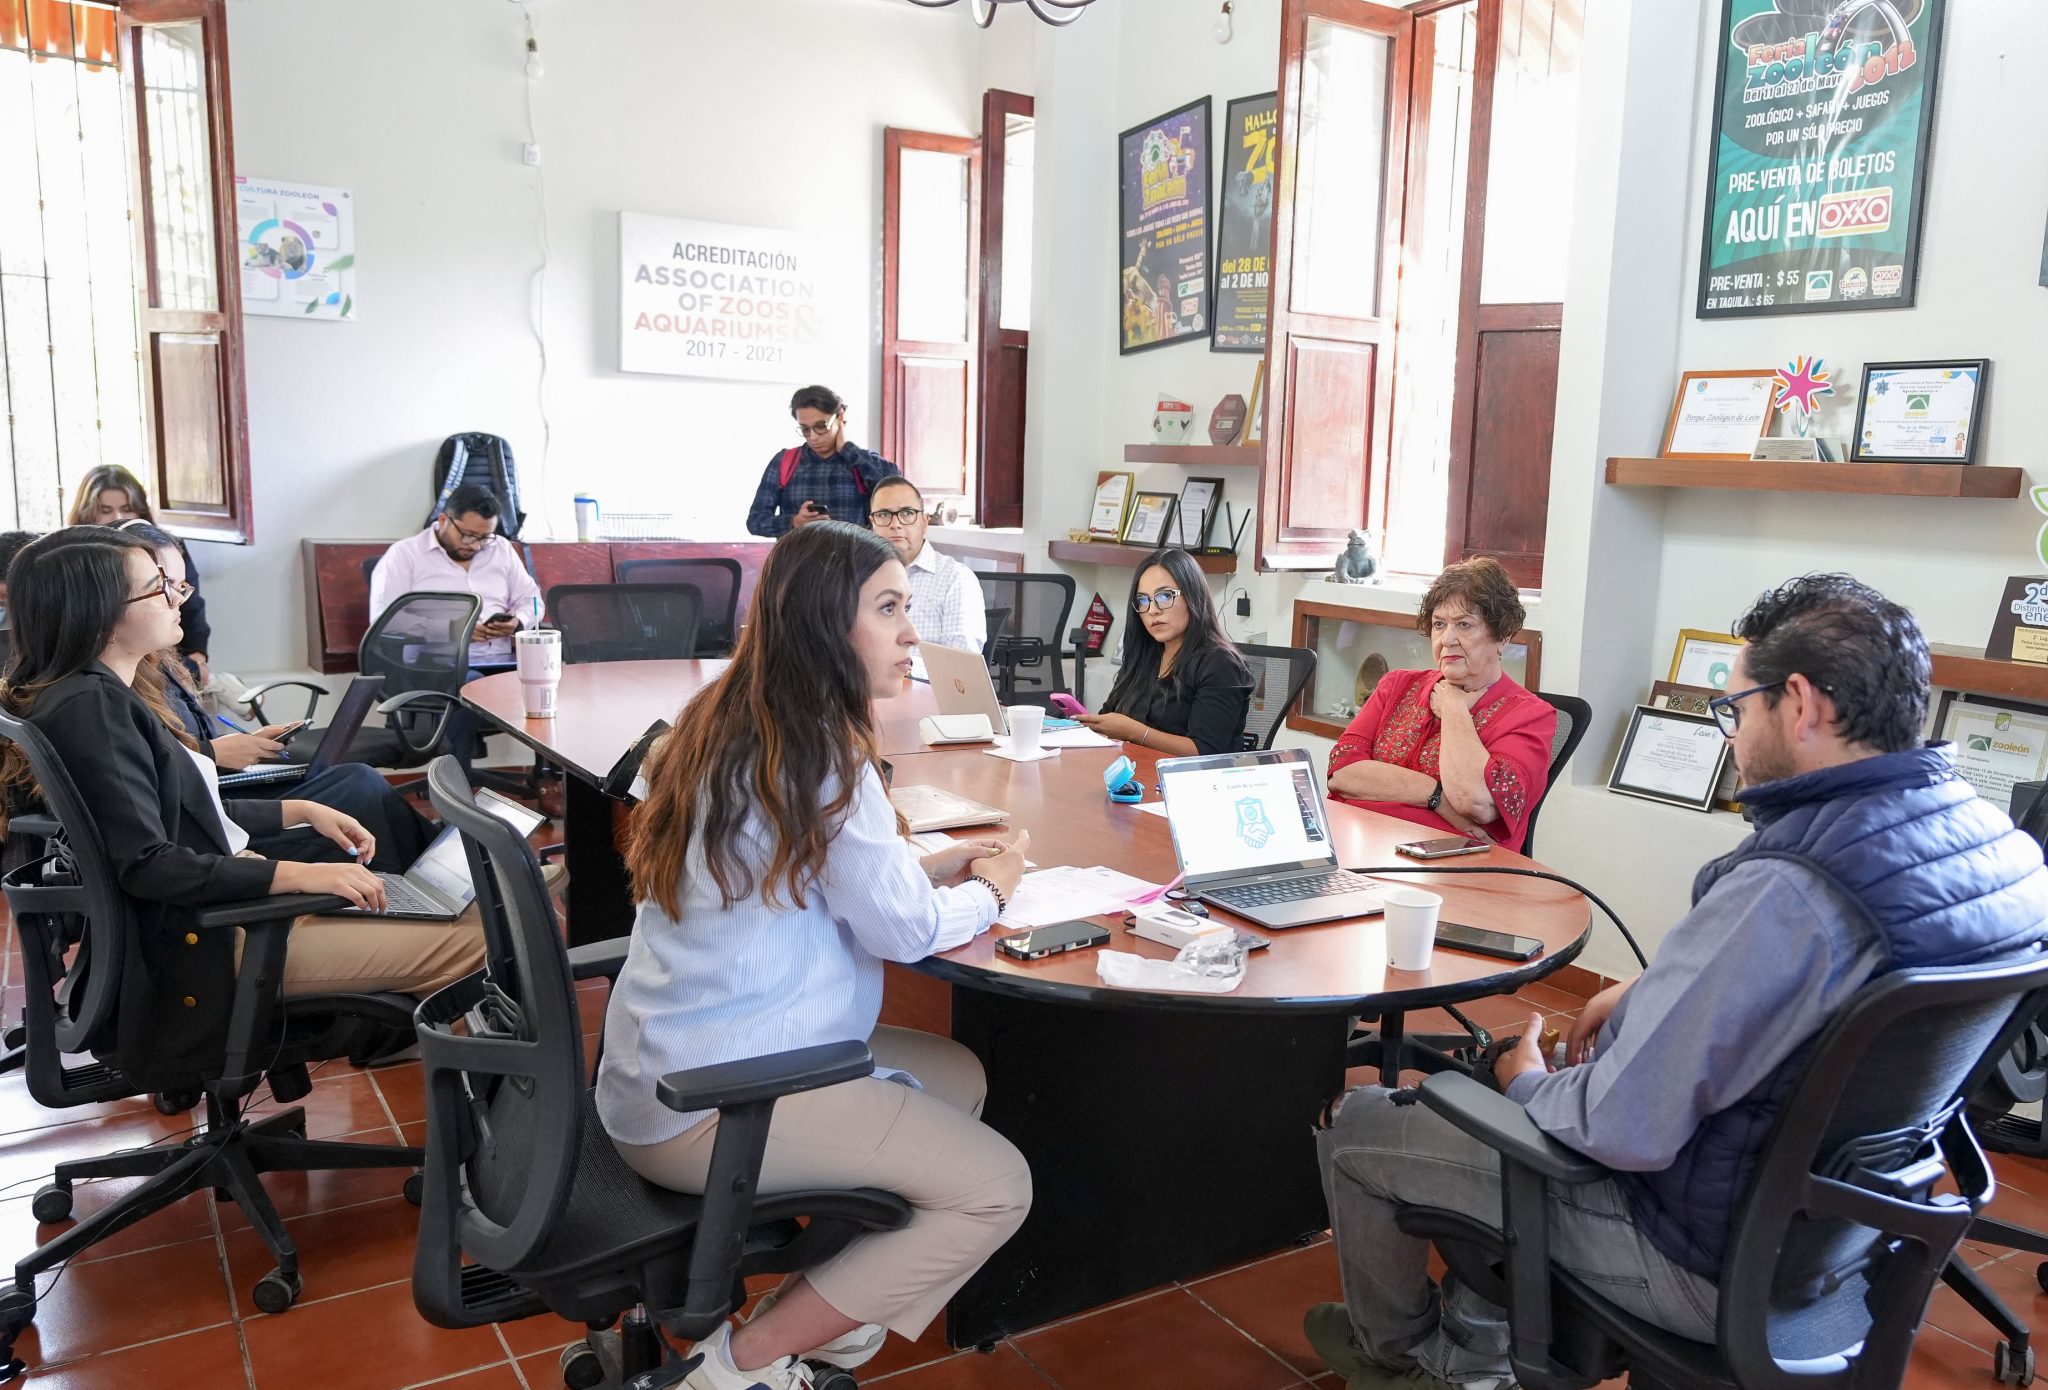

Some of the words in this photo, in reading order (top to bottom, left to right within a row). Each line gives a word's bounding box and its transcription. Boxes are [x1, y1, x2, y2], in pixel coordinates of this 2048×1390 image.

[1750, 39, 1805, 65] Feria
[1745, 88, 1761, 102] Del
[1775, 84, 1786, 98] al
[1801, 79, 1814, 92] de
[1745, 107, 1794, 128] ZOOLÓGICO
[1806, 100, 1841, 118] SAFAR
[1852, 90, 1890, 110] JUEGOS
[1766, 130, 1784, 146] POR
[1787, 128, 1799, 142] UN
[1729, 164, 1801, 193] PRE-VENTA
[1806, 161, 1825, 183] DE
[1828, 150, 1896, 179] BOLETOS
[1725, 194, 1786, 245] AQUÍ
[1786, 199, 1817, 238] EN
[1820, 197, 1889, 230] OXXO
[672, 242, 797, 271] ACREDITACIÓN
[1222, 259, 1236, 273] del
[1238, 257, 1251, 272] 28
[1253, 256, 1266, 272] DE
[634, 264, 814, 299] ASSOCIATION
[1221, 274, 1230, 288] al
[1231, 273, 1238, 288] 2
[1240, 272, 1253, 288] DE
[1710, 273, 1763, 291] PRE-VENTA
[1787, 270, 1800, 286] 55
[1874, 270, 1900, 280] OXXO
[678, 292, 713, 312] OF
[719, 296, 789, 319] ZOOS
[1706, 298, 1717, 309] EN
[633, 312, 789, 343] AQUARIUMS
[686, 339, 726, 358] 2017
[746, 345, 783, 362] 2021
[1993, 741, 2030, 754] zooleón
